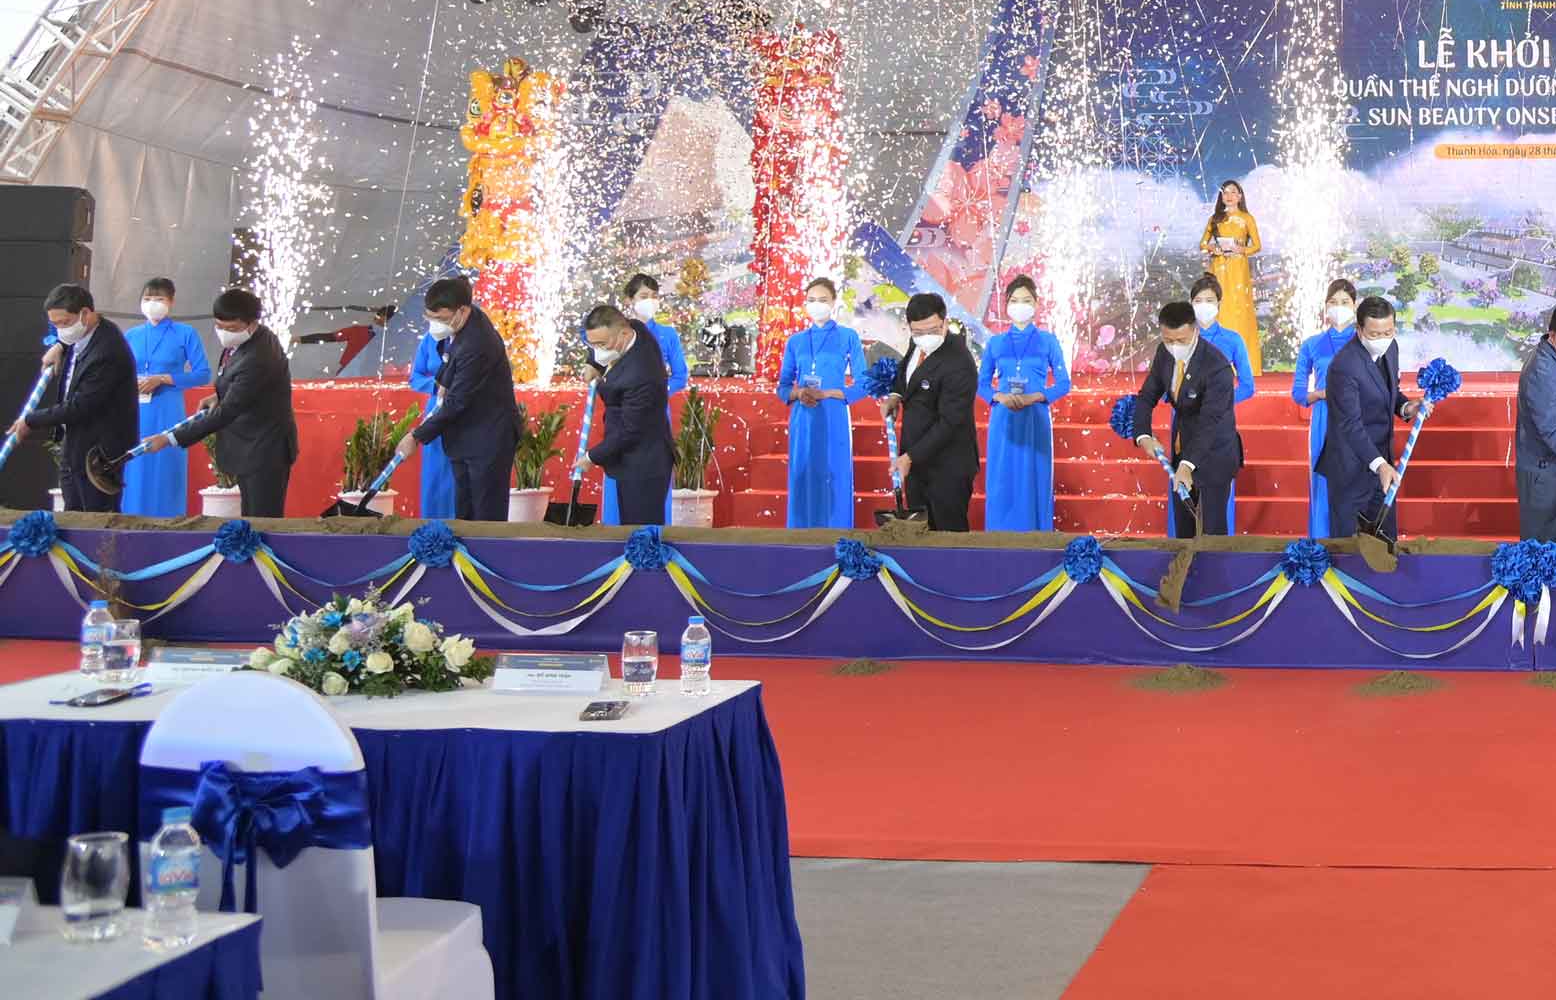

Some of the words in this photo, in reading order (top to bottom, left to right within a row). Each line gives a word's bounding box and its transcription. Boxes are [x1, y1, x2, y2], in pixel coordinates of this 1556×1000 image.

[1501, 0, 1523, 9] TỈNH
[1525, 0, 1556, 9] THANH
[1418, 27, 1455, 68] LỄ
[1466, 32, 1551, 69] KHỞI
[1334, 74, 1393, 99] QUẦN
[1399, 73, 1441, 97] THỂ
[1368, 107, 1412, 126] SUN
[1419, 107, 1501, 126] BEAUTY
[1447, 146, 1476, 156] Thanh
[1503, 146, 1526, 158] ngày
[1529, 146, 1541, 156] 28
